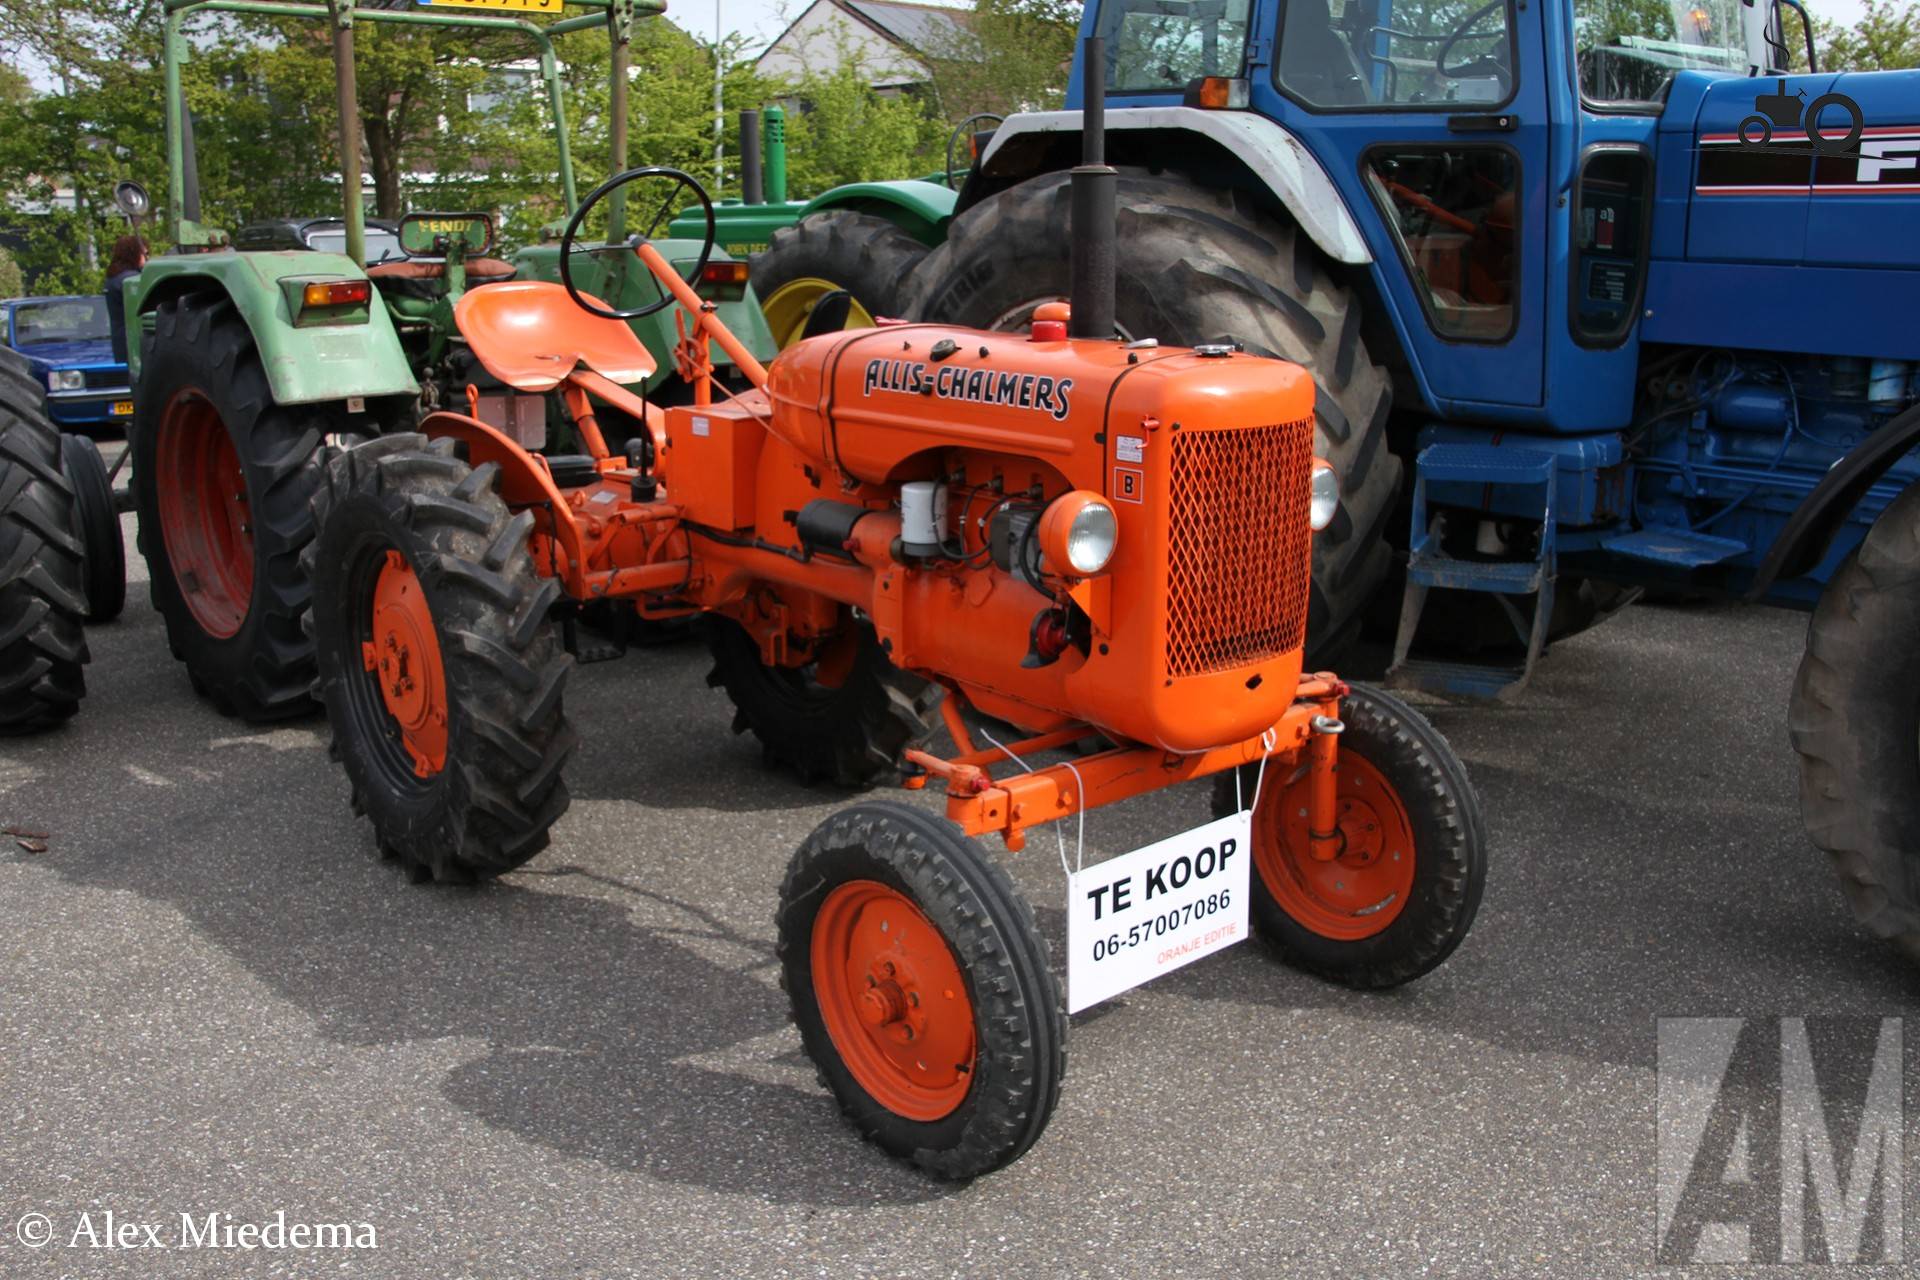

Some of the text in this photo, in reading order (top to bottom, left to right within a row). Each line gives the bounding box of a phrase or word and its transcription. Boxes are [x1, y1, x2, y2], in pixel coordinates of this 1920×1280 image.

[864, 359, 1073, 421] ALLIS-CHALMERS
[1124, 475, 1134, 494] B
[1087, 838, 1237, 920] TE KOOP
[1093, 888, 1231, 962] 06-57007086
[1157, 921, 1237, 965] ORANJE EDITIE
